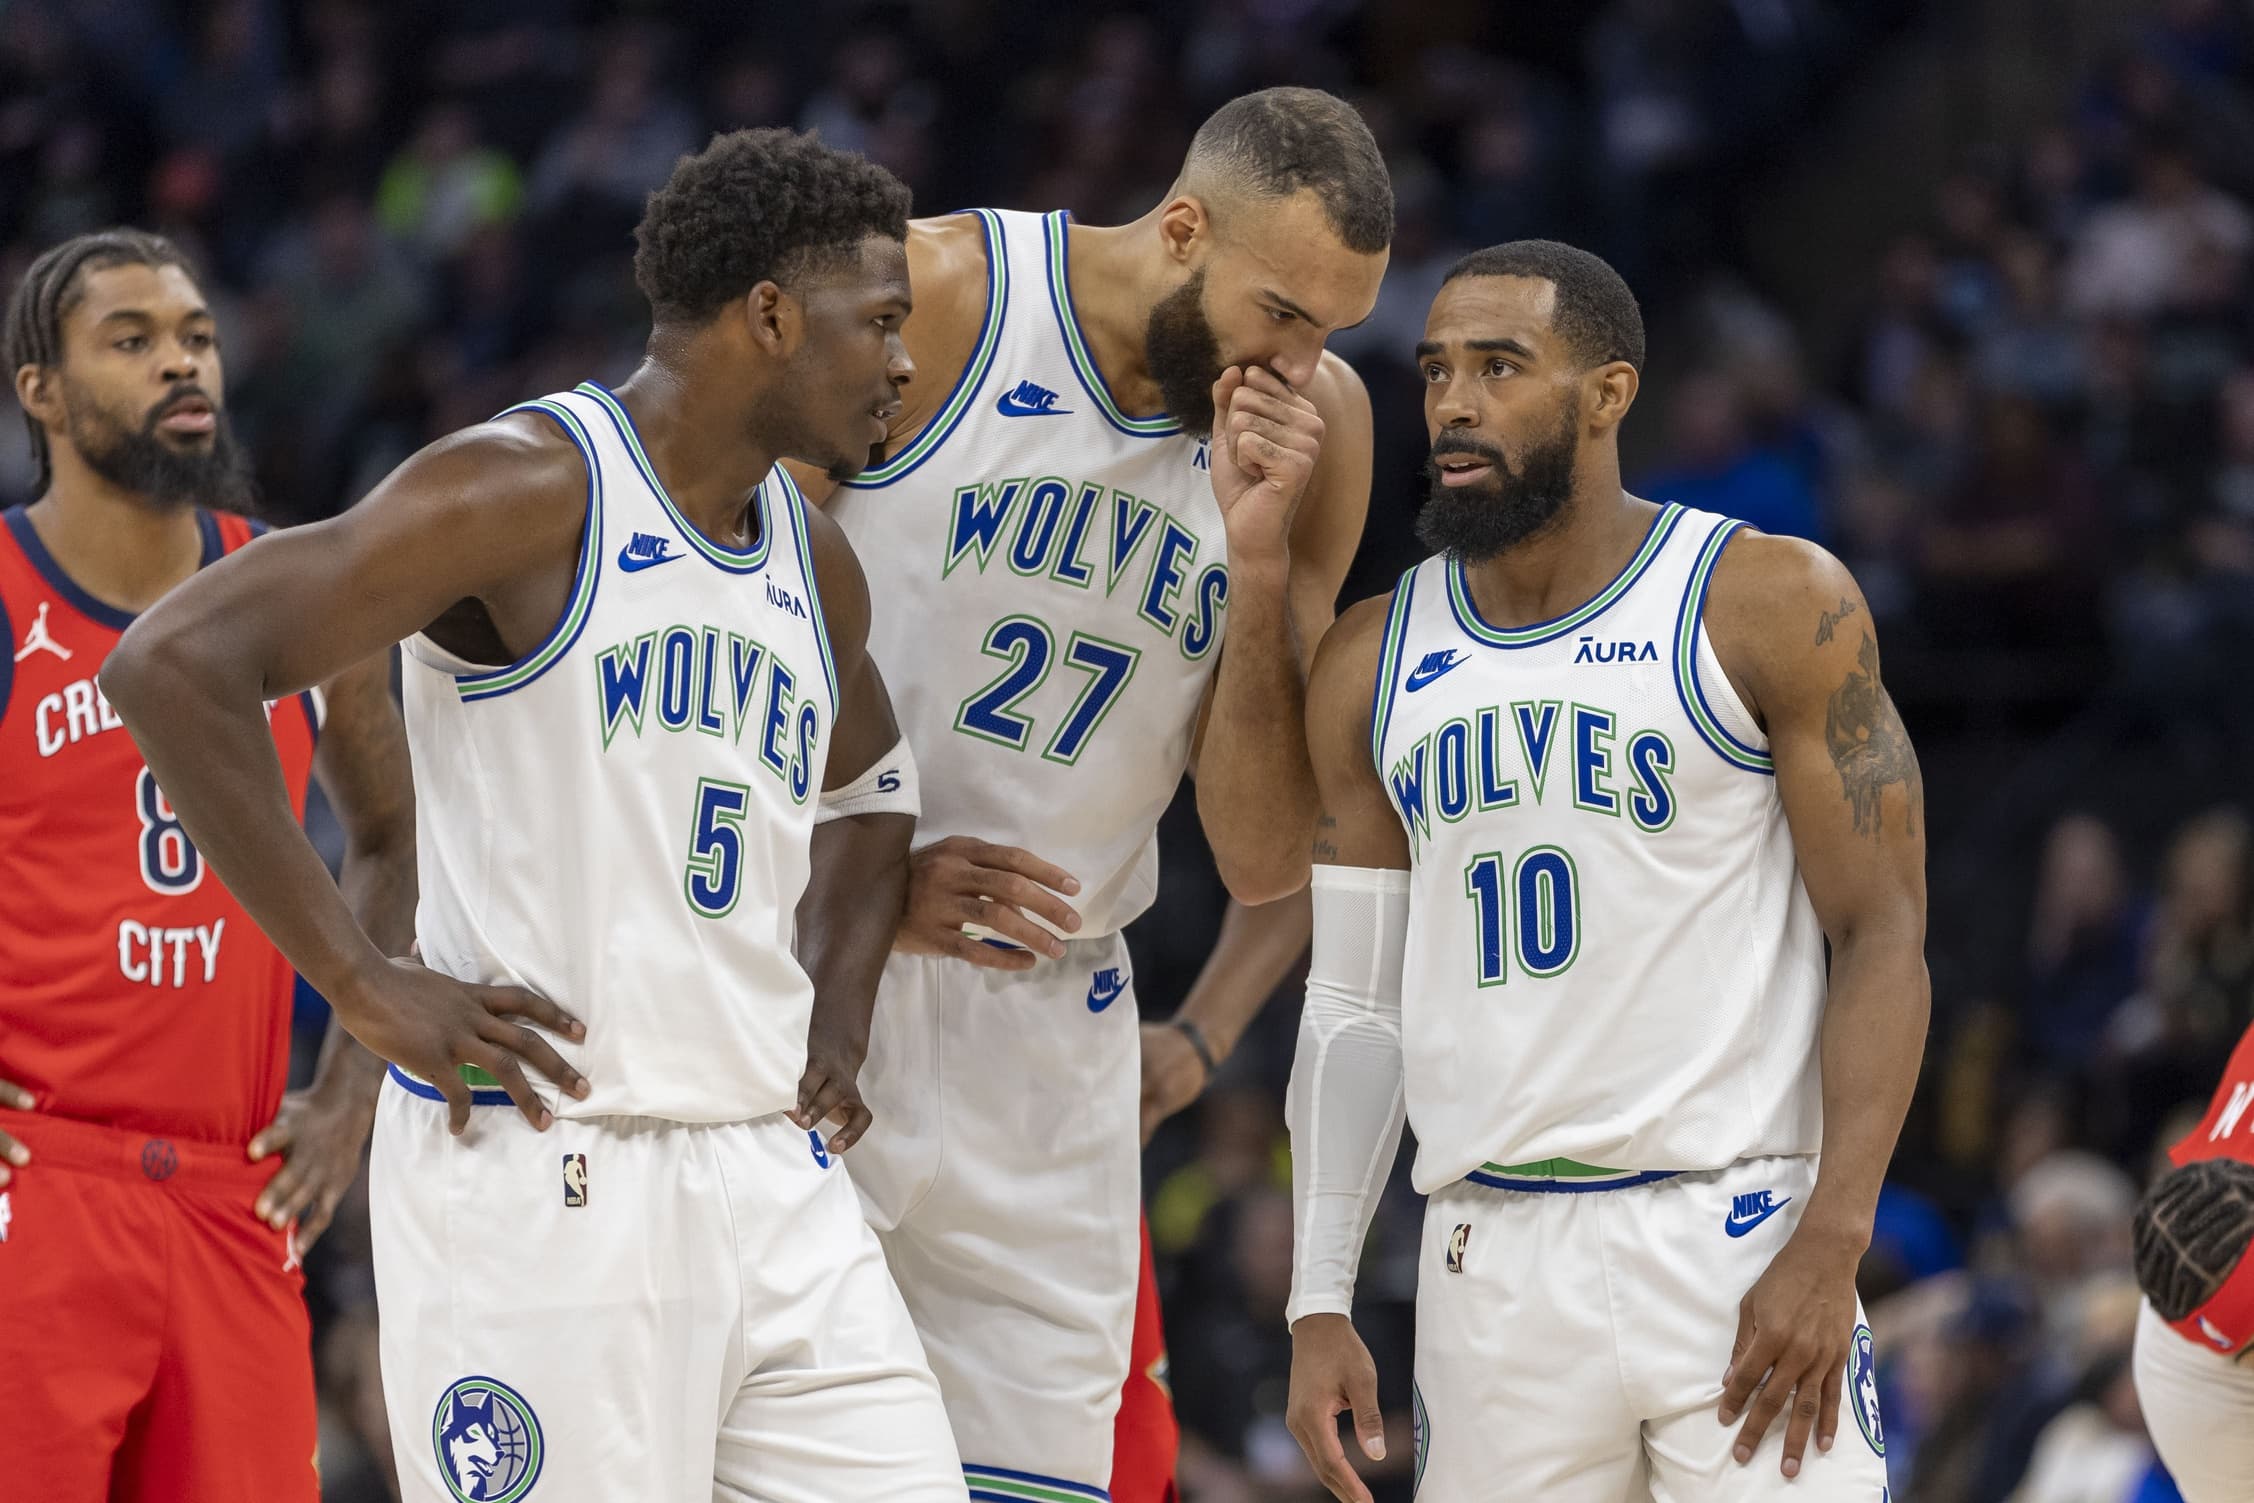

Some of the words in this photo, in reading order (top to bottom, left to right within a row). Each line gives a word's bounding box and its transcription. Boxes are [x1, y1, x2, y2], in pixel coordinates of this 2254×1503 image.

[1011, 379, 1059, 410] NIKE
[628, 532, 670, 560] NIKE
[942, 475, 1229, 662] WOLVES
[953, 613, 1142, 767] 27
[1416, 648, 1458, 675] NIKE
[594, 624, 819, 805] WOLVES
[878, 770, 900, 793] 5
[1389, 699, 1677, 865] WOLVES
[684, 776, 751, 919] 5
[1464, 844, 1581, 988] 10
[118, 917, 226, 988] CITY
[1093, 967, 1120, 995] NIKE
[1732, 1189, 1776, 1220] NIKE
